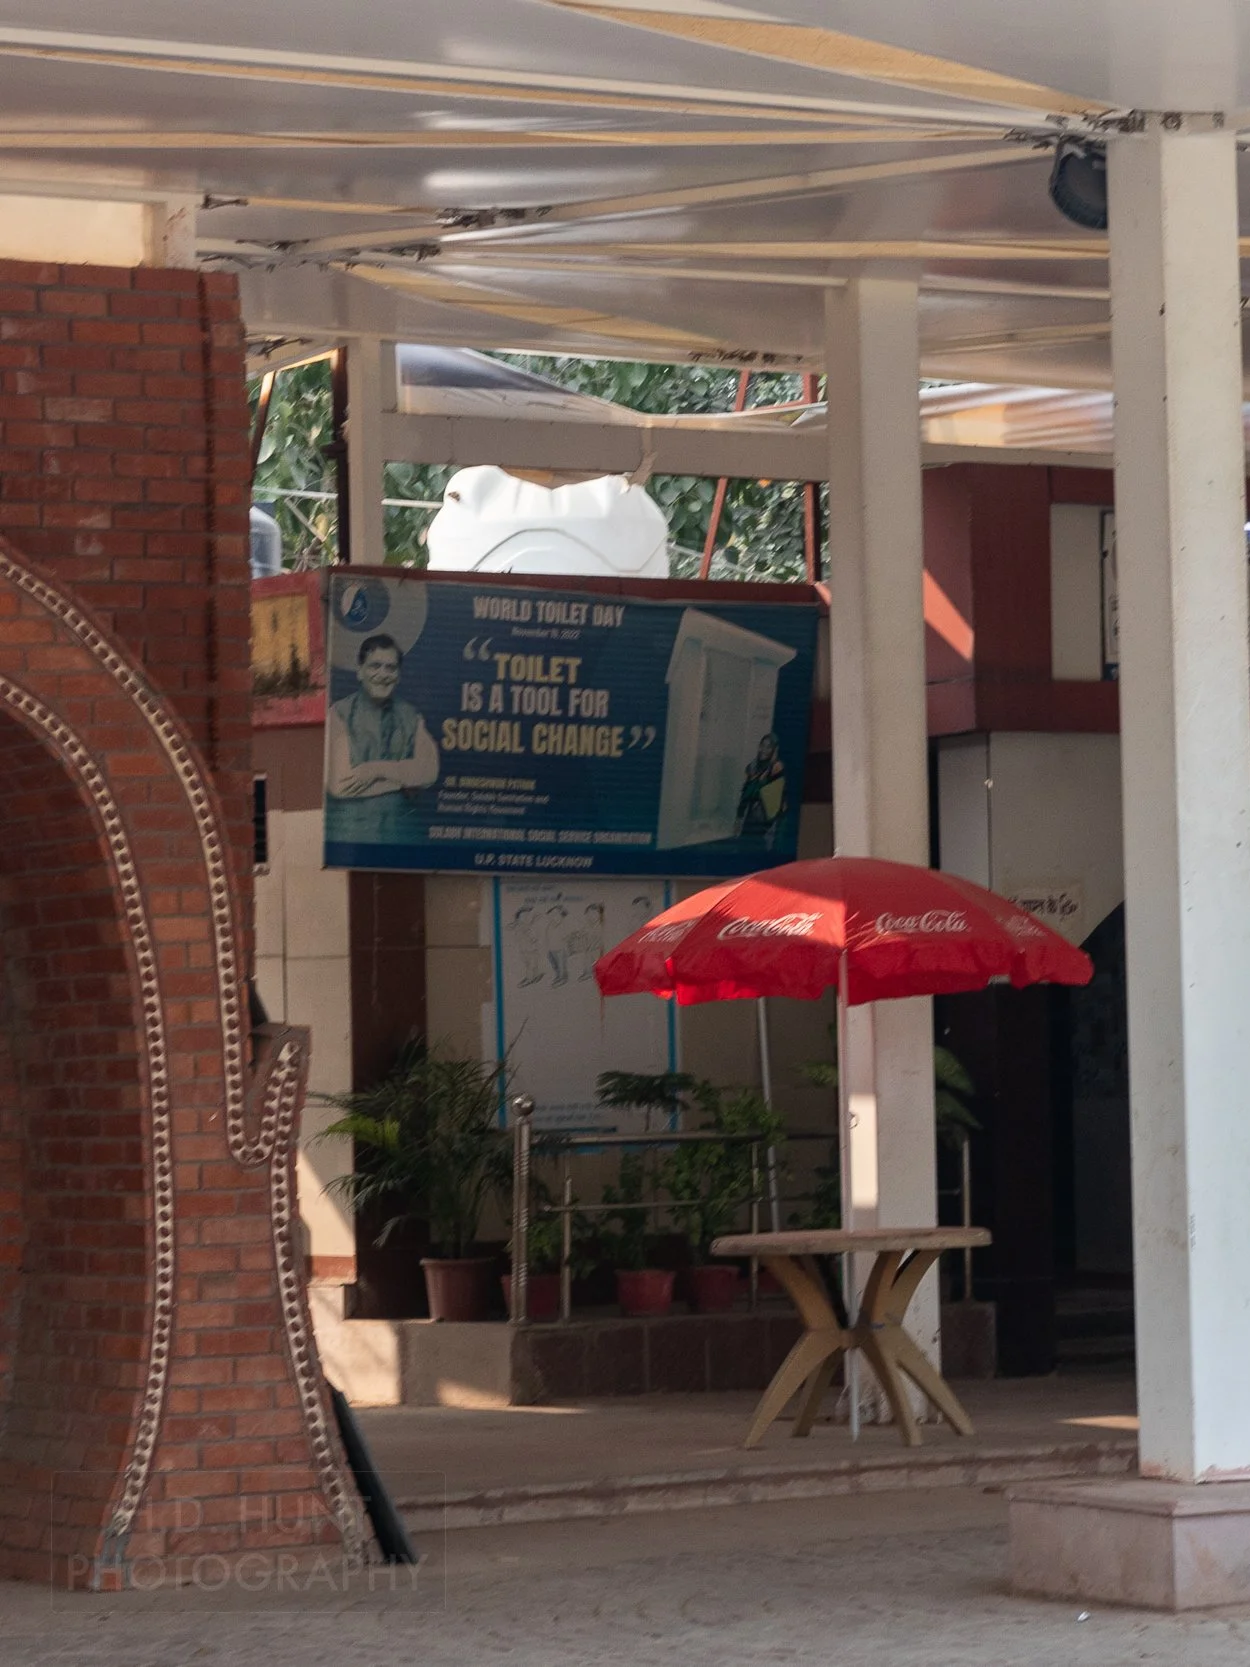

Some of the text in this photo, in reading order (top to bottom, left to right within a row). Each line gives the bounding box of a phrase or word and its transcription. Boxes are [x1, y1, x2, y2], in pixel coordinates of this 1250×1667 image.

[473, 596, 626, 628] WORLD TOILET DAY
[461, 682, 610, 719] IS A TOOL FOR
[442, 720, 524, 753] SOCIAL
[473, 852, 594, 869] U.P. STATE LUCKNOW
